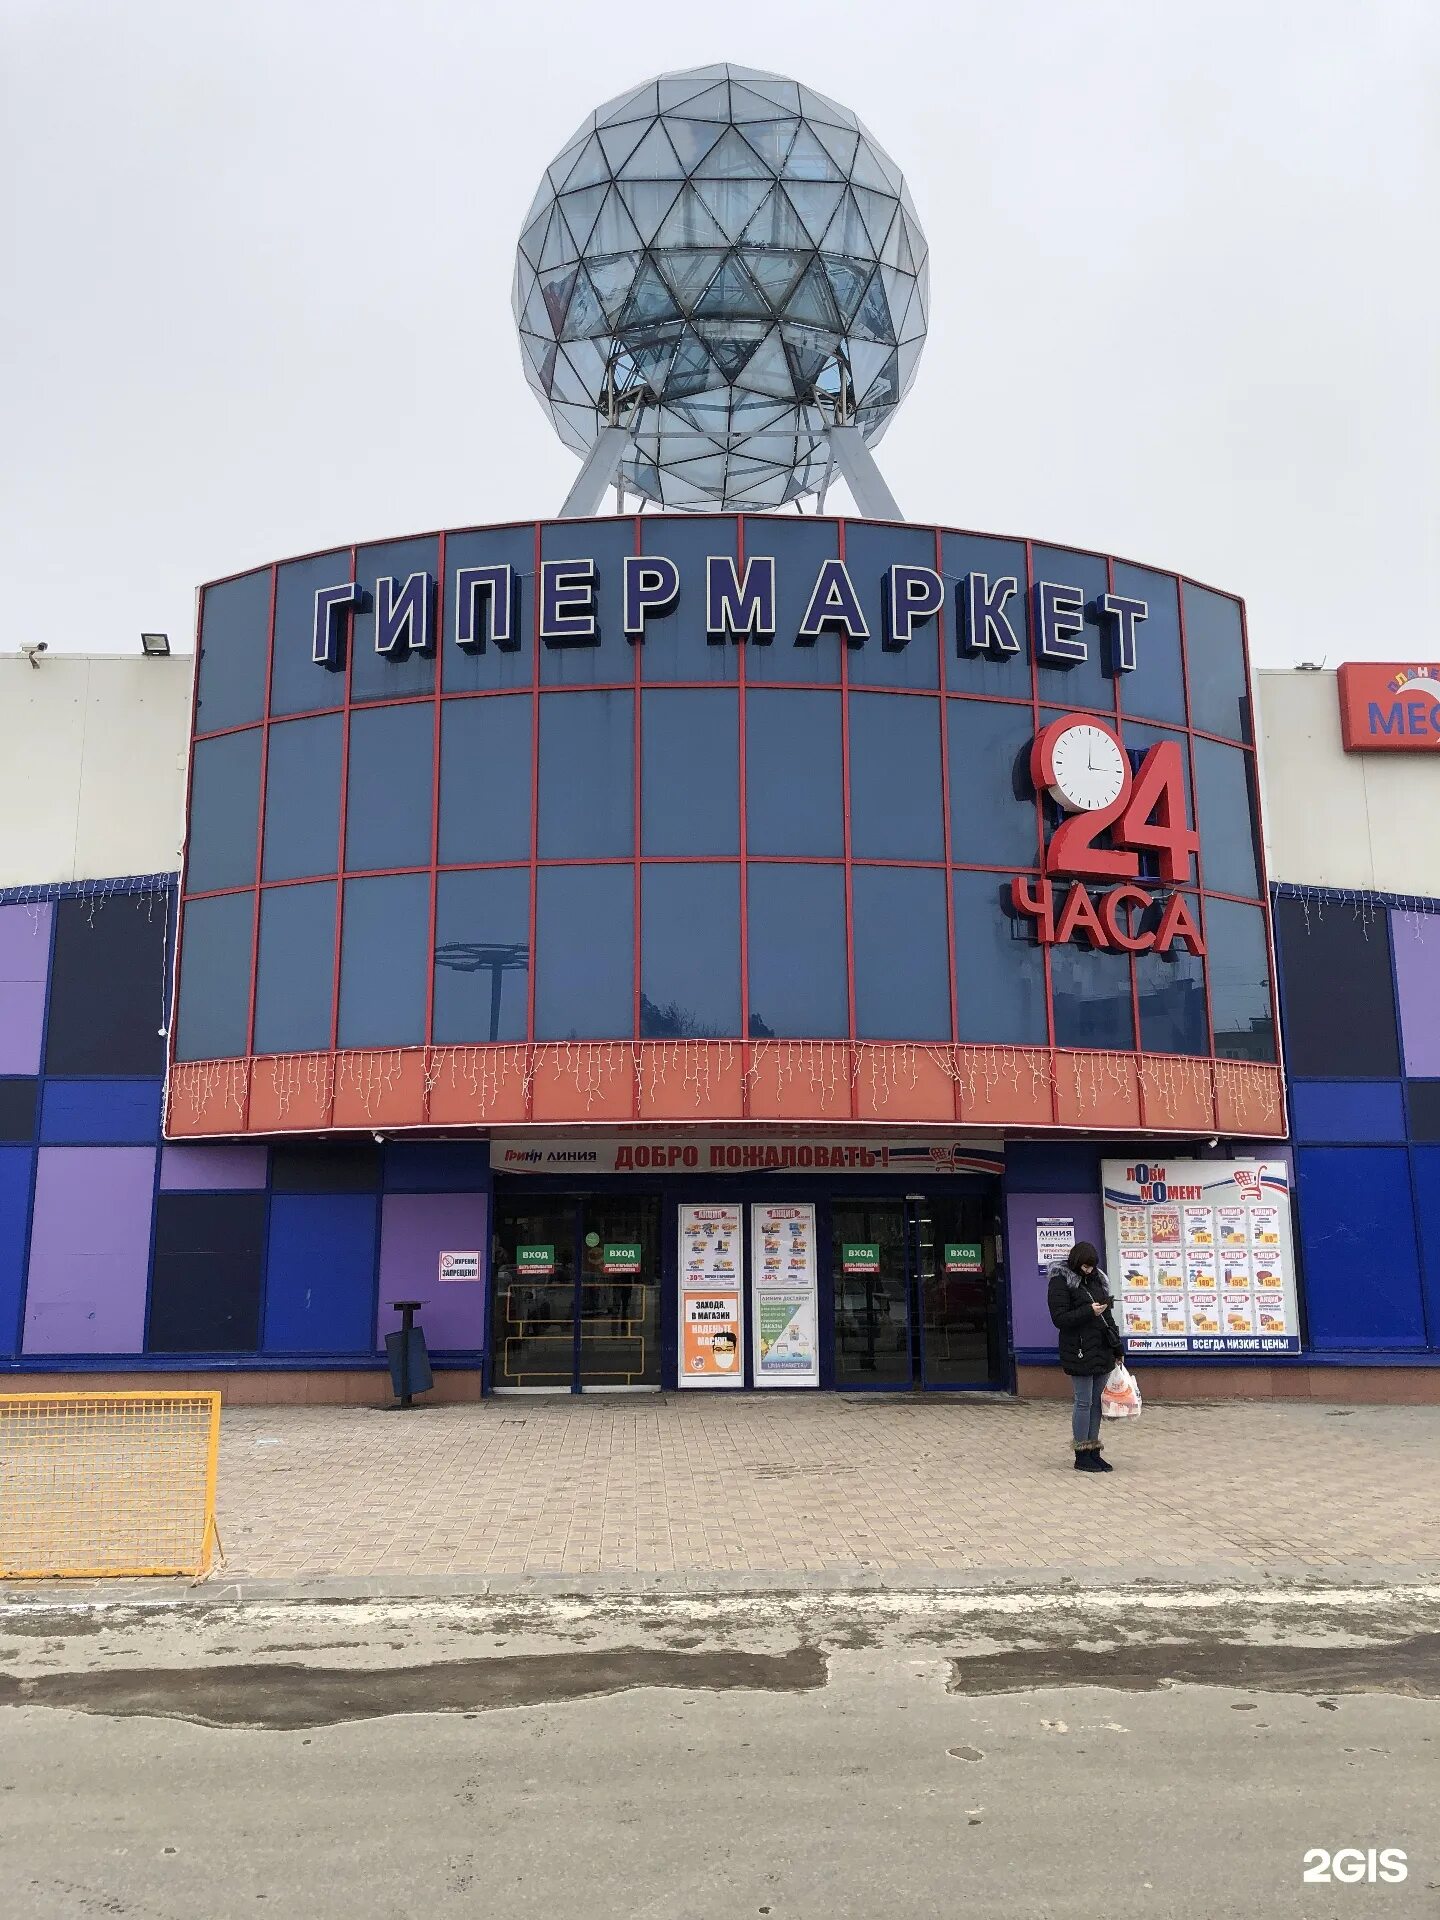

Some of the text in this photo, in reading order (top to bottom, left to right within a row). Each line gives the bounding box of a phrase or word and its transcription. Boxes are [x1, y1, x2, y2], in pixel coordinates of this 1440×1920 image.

[311, 555, 1150, 673] ГИПЕРМАРКЕТ
[1030, 712, 1200, 884] 24
[1011, 876, 1207, 956] ЧАСА
[547, 1151, 597, 1162] ЛИНИЯ
[614, 1145, 699, 1170] ДОБРО
[710, 1145, 889, 1168] ПОЖАЛОВАТЬ!
[1126, 1163, 1166, 1184] ЛОВИ
[1140, 1182, 1203, 1203] МОМЕНТ
[522, 1251, 549, 1260] ВХОД
[609, 1250, 636, 1258] ВХОД
[848, 1250, 874, 1258] ВХОД
[950, 1250, 976, 1258] ВХОД
[442, 1269, 478, 1277] ЗАПРЕЩЕНО!
[696, 1300, 726, 1310] ЗАХОДЯ,
[692, 1312, 730, 1320] В МАГАЗИН
[692, 1324, 732, 1334] НАДЕНЬТЕ
[1192, 1339, 1225, 1350] ВСЕГДА
[1227, 1339, 1261, 1349] НИЗКИЕ
[1262, 1339, 1289, 1350] ЦЕНЫ!
